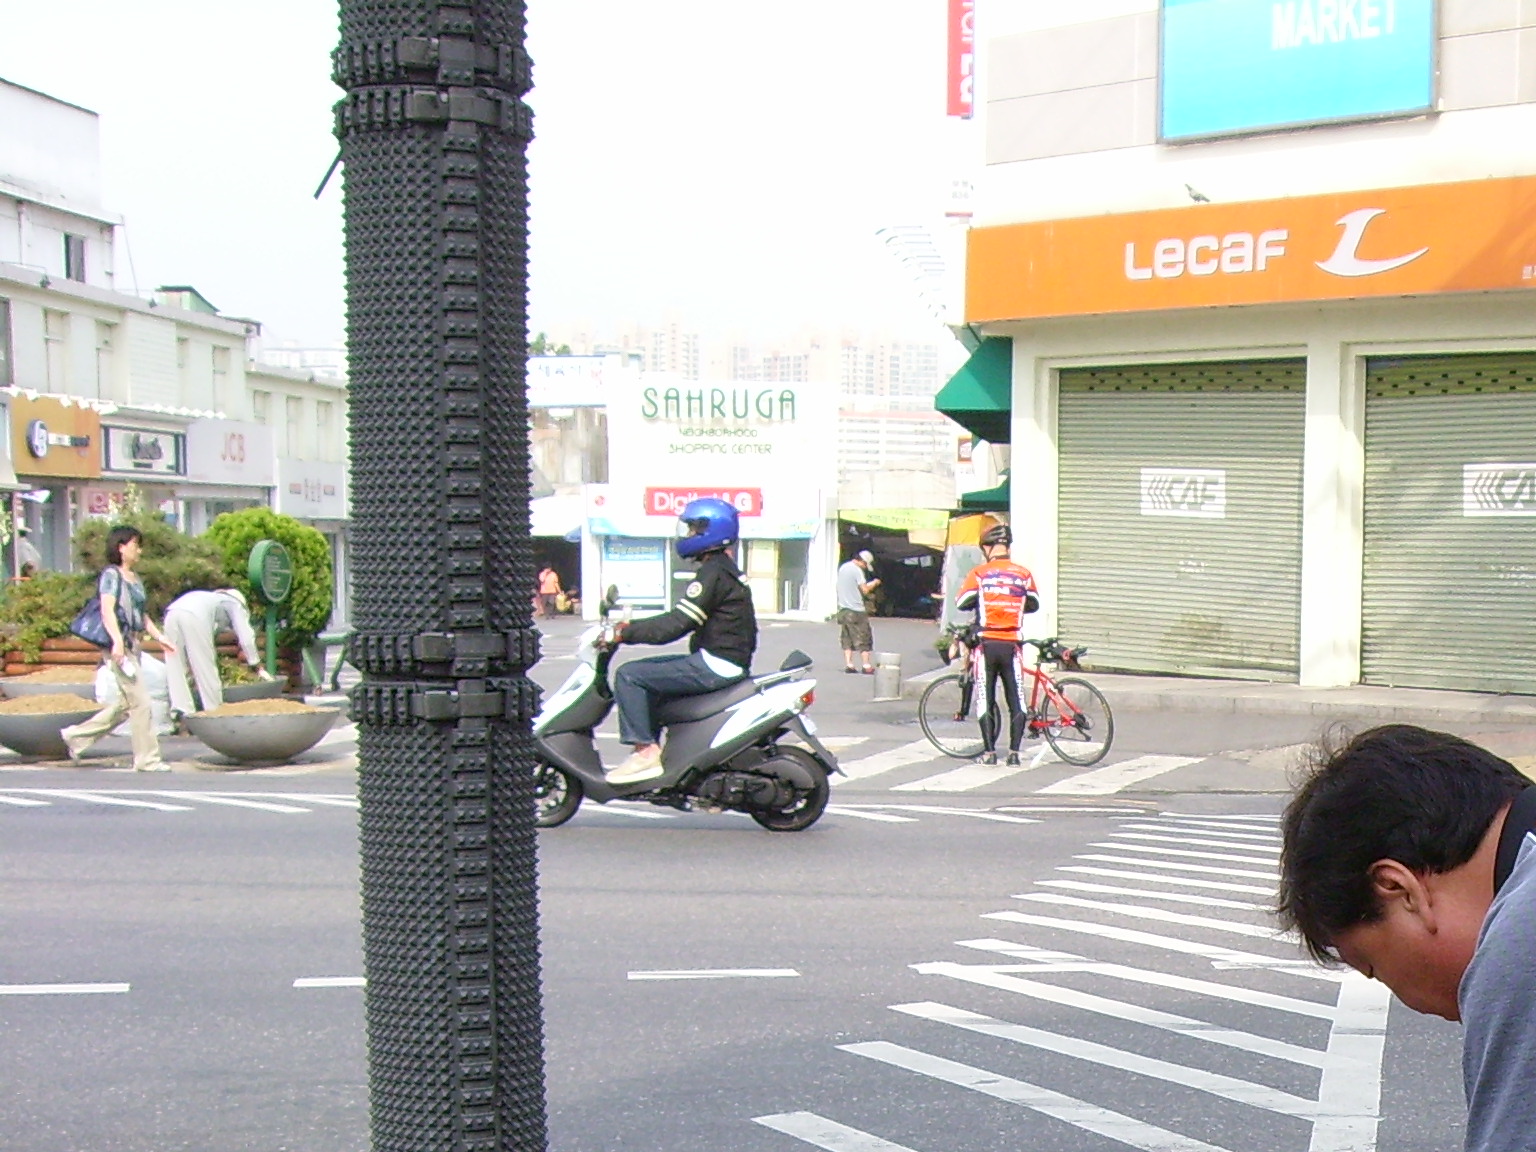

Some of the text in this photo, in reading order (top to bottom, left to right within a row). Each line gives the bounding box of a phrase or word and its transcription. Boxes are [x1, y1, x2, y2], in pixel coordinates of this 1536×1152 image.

[1270, 0, 1395, 50] MARKET
[641, 387, 796, 419] SAHRUGA
[668, 443, 772, 455] SHOPPING CENTER
